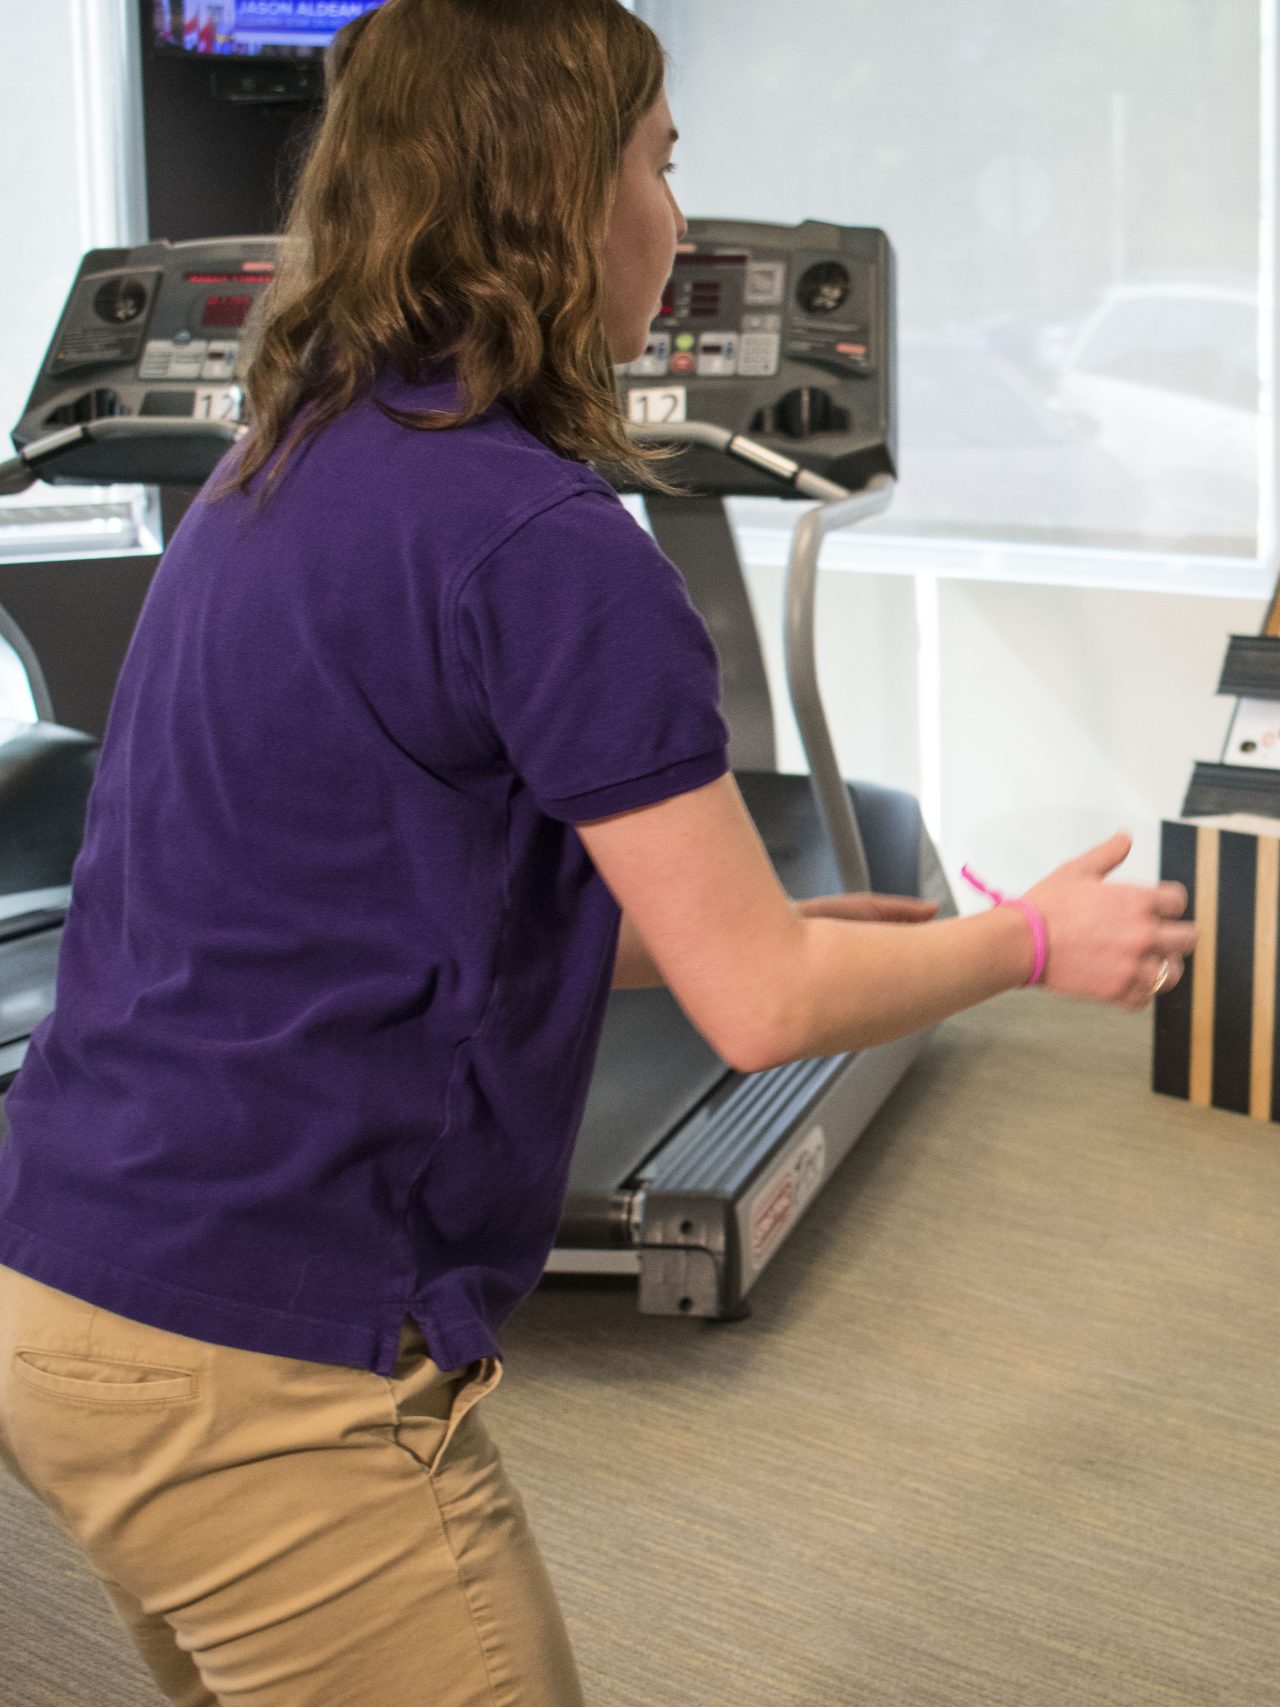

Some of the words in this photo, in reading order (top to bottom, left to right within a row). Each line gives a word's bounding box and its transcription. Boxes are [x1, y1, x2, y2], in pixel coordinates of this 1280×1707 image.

[236, 0, 293, 15] JASON
[296, 1, 363, 17] ALDEAN
[636, 393, 679, 423] 12
